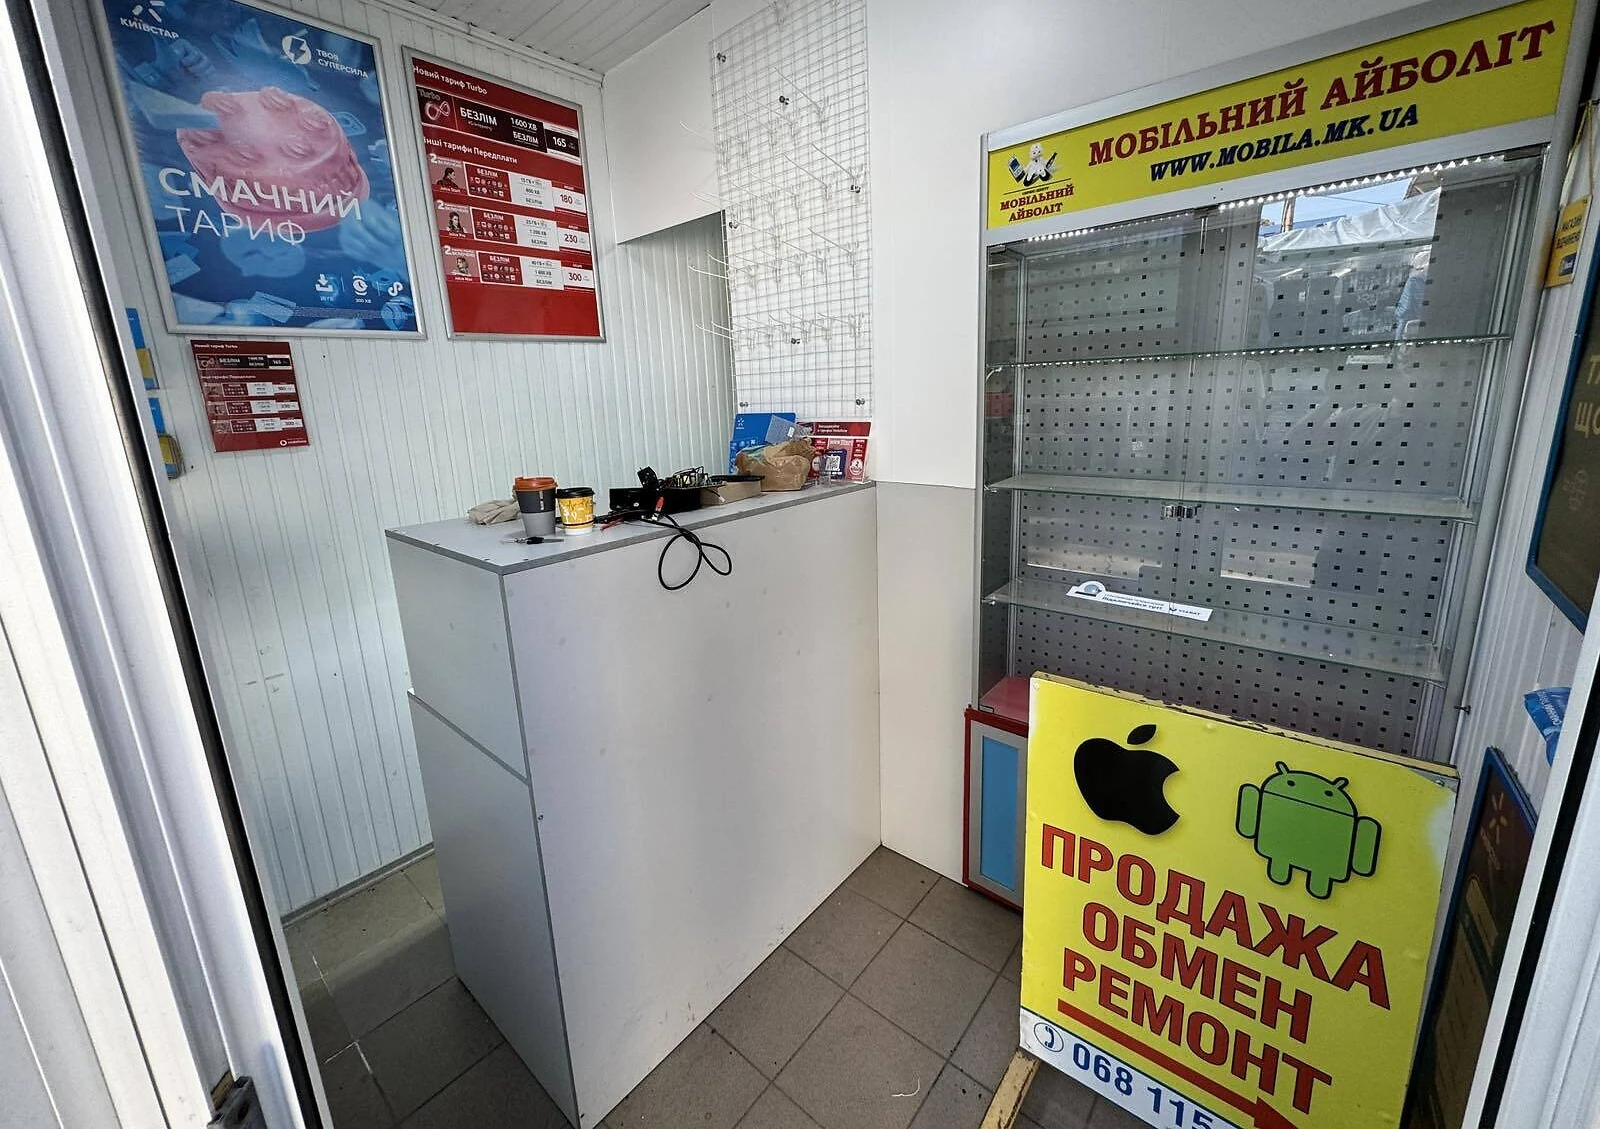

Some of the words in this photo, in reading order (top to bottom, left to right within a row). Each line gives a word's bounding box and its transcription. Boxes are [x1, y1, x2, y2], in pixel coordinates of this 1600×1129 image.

[120, 17, 179, 39] КИЇВСТАР
[316, 49, 339, 61] ТВОЯ
[318, 59, 369, 79] СУПЕРСИЛА
[413, 66, 440, 80] Новий
[440, 75, 466, 90] тариф
[466, 81, 488, 95] Turbo
[1089, 78, 1308, 166] МОБІЛЬНИЙ
[1320, 20, 1556, 110] АЙБОЛІТ
[460, 107, 498, 126] БЕЗЛІМ
[512, 131, 539, 144] БЕЗЛІМ
[552, 136, 567, 148] 165
[1151, 104, 1418, 181] WWW.MOBILA.MK.UA
[429, 153, 438, 163] 2
[443, 141, 473, 154] тарифи
[473, 147, 518, 164] Передплати
[158, 167, 361, 221] СМАЧНИЙ
[560, 194, 573, 205] 180
[1000, 184, 1075, 211] МОБІЛЬНИЙ
[1009, 202, 1064, 223] АЙБОЛІТ
[164, 205, 306, 245] ТАРИФ
[564, 233, 578, 244] 230
[568, 272, 582, 282] 300
[1041, 823, 1391, 1011] ПРОДАЖА
[1082, 902, 1312, 1043] ОБМЕН
[1062, 948, 1333, 1115] РЕМОНТ
[1073, 1042, 1133, 1097] 068
[1147, 1085, 1214, 1129] 115
